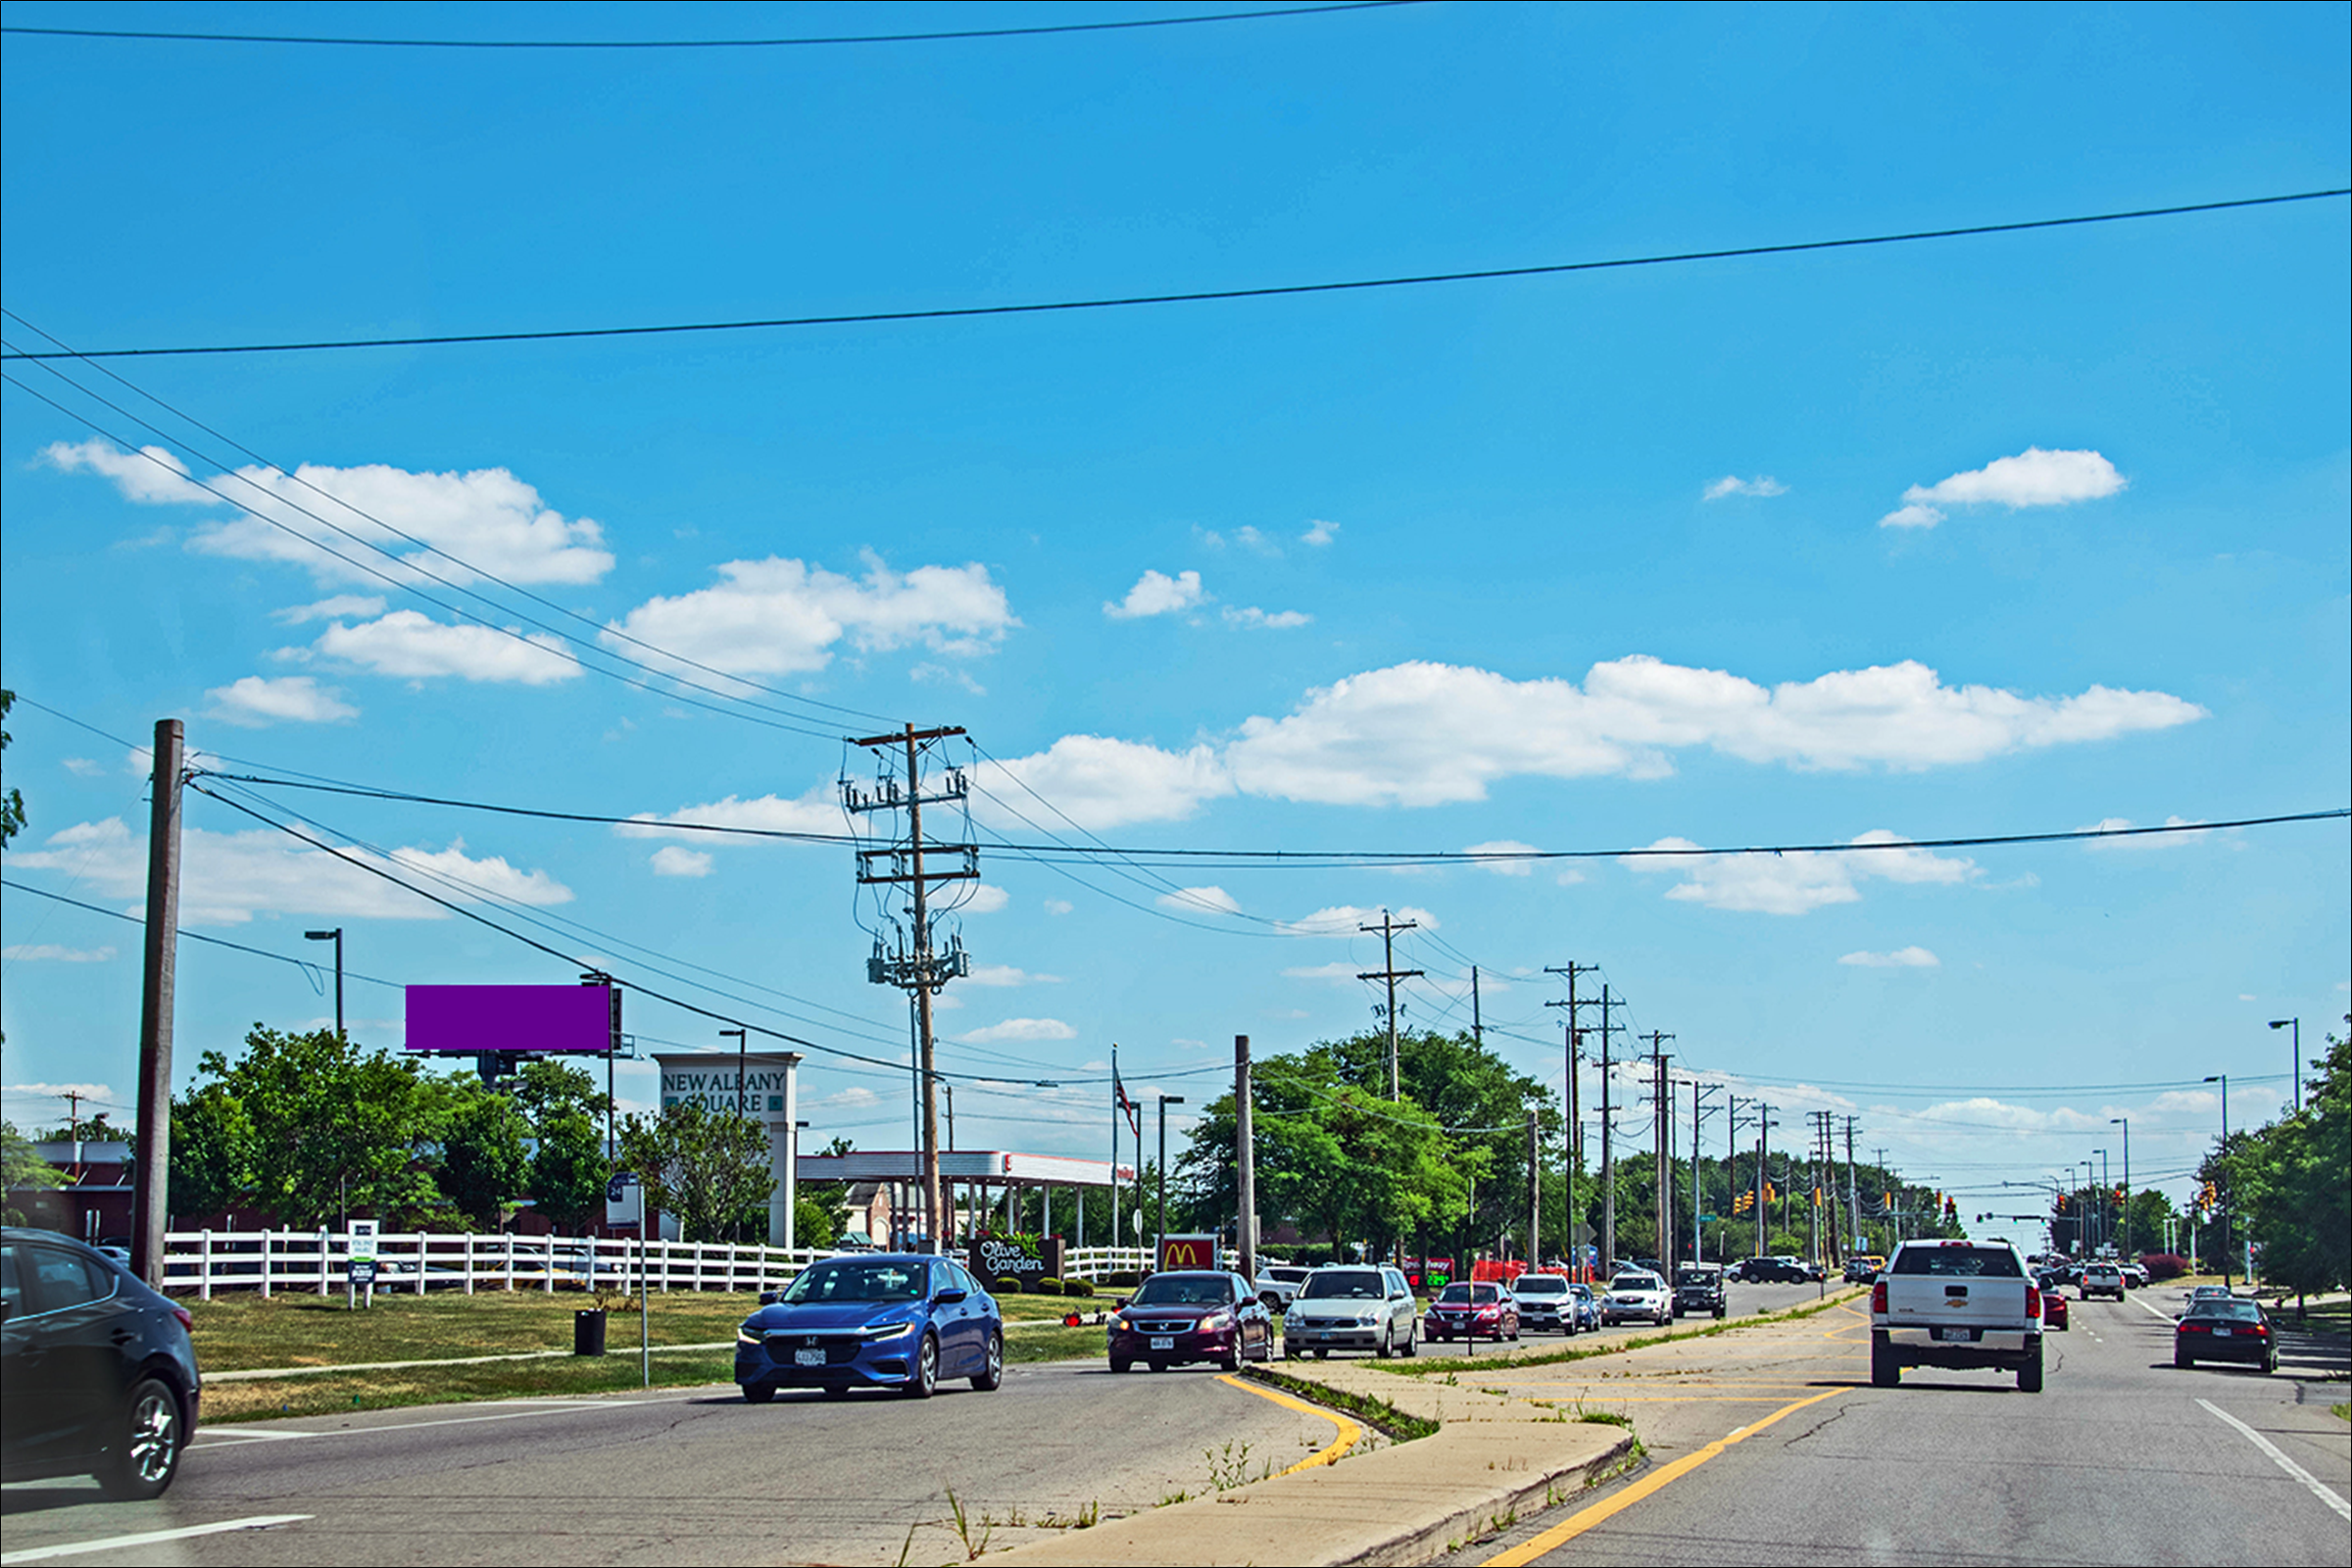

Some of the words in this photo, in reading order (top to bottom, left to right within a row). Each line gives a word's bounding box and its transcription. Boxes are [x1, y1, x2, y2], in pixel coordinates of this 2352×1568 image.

[662, 1073, 708, 1091] NEW
[611, 1187, 621, 1196] 24
[980, 1241, 1021, 1258] Olive
[986, 1255, 1045, 1276] Garden
